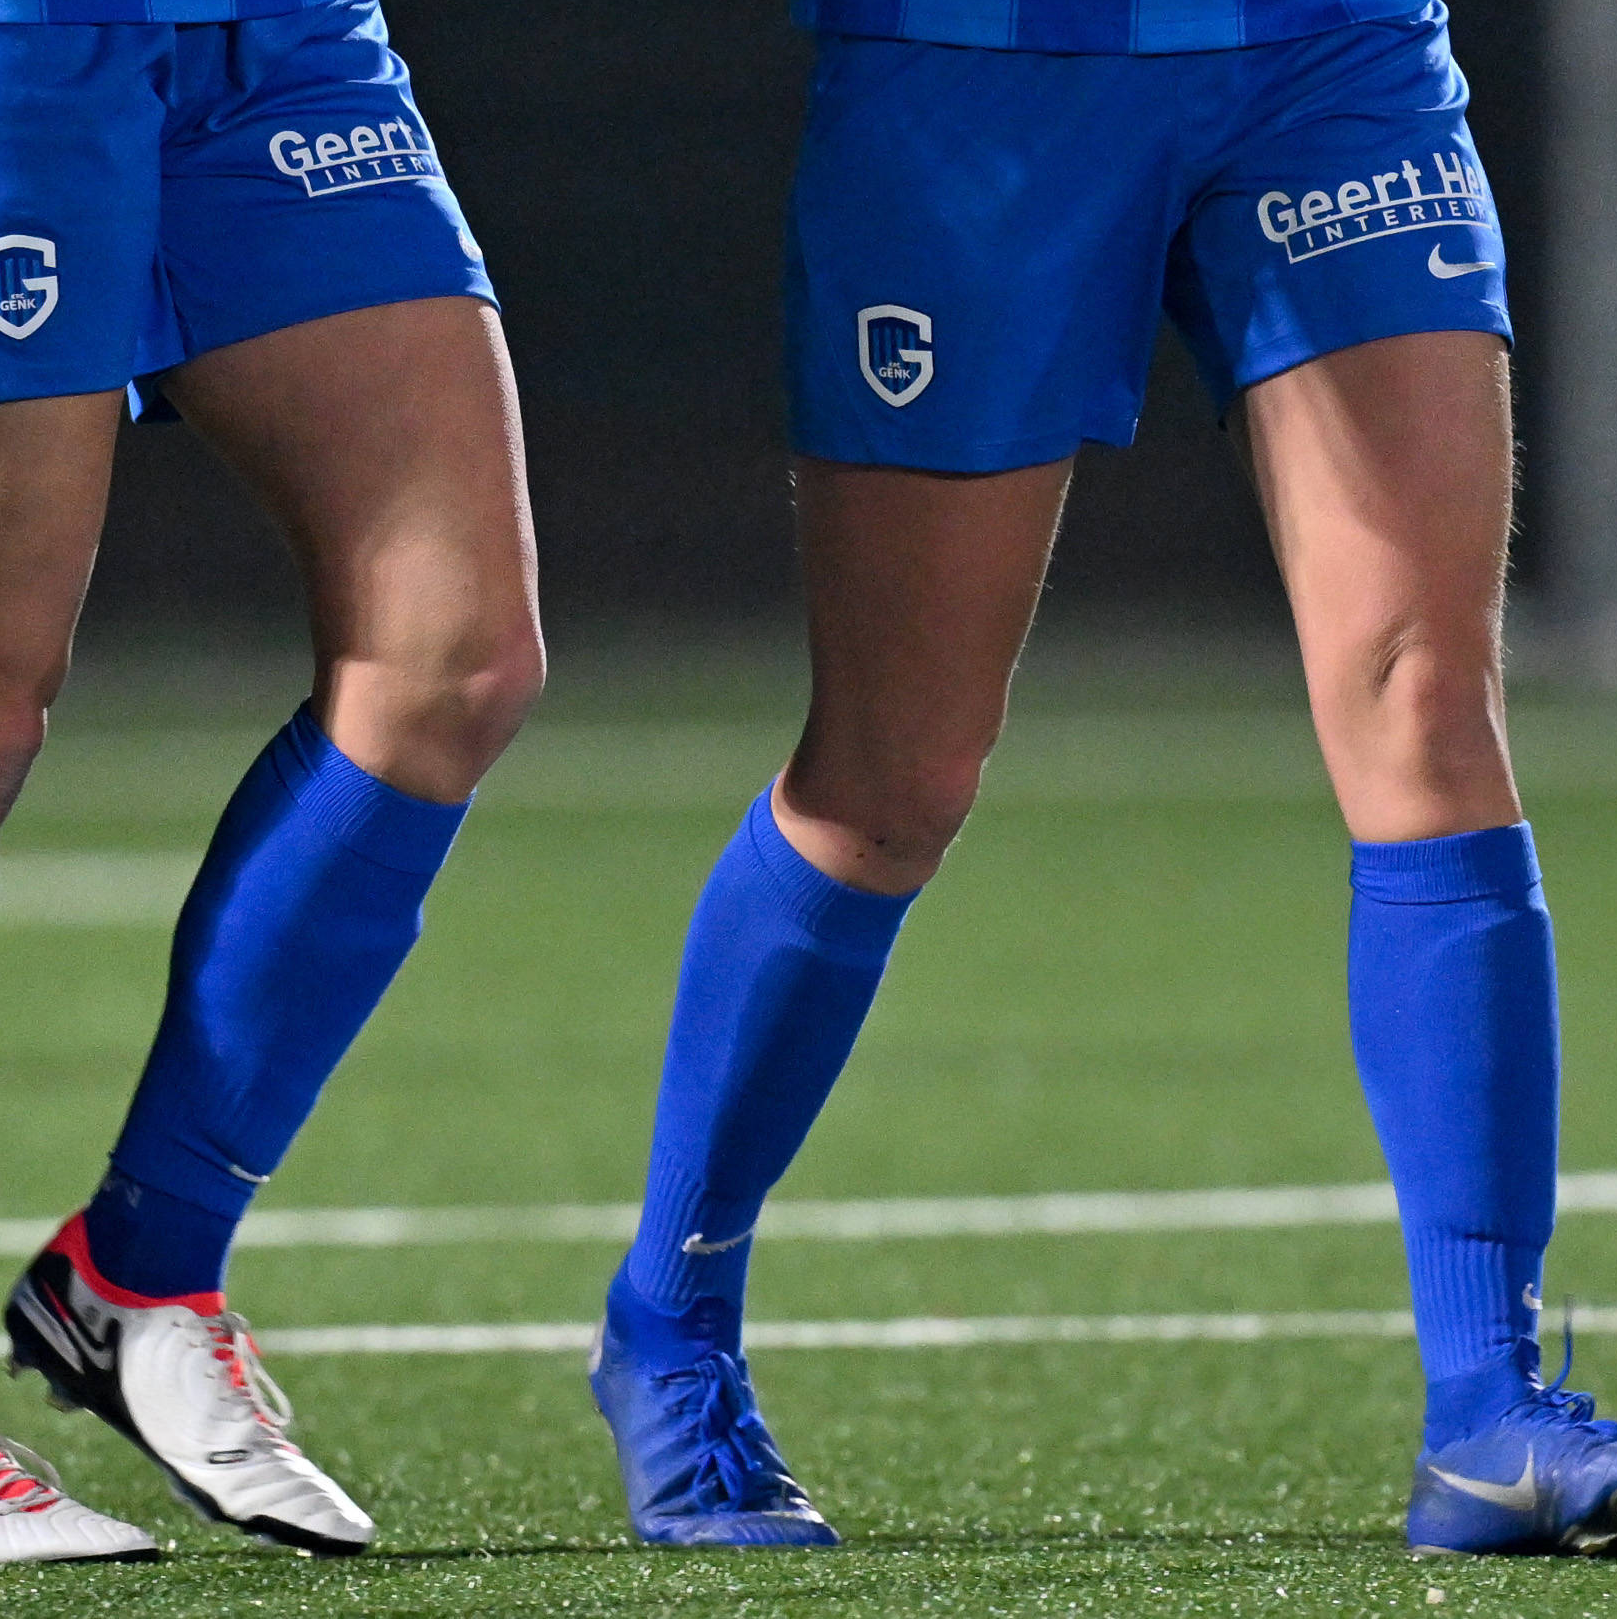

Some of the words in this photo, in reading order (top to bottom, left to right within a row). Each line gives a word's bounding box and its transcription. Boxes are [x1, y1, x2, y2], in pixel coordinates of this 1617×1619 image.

[269, 116, 414, 176] Geert
[1257, 160, 1422, 243] Geert
[0, 298, 37, 311] GENK
[878, 366, 912, 380] GENK
